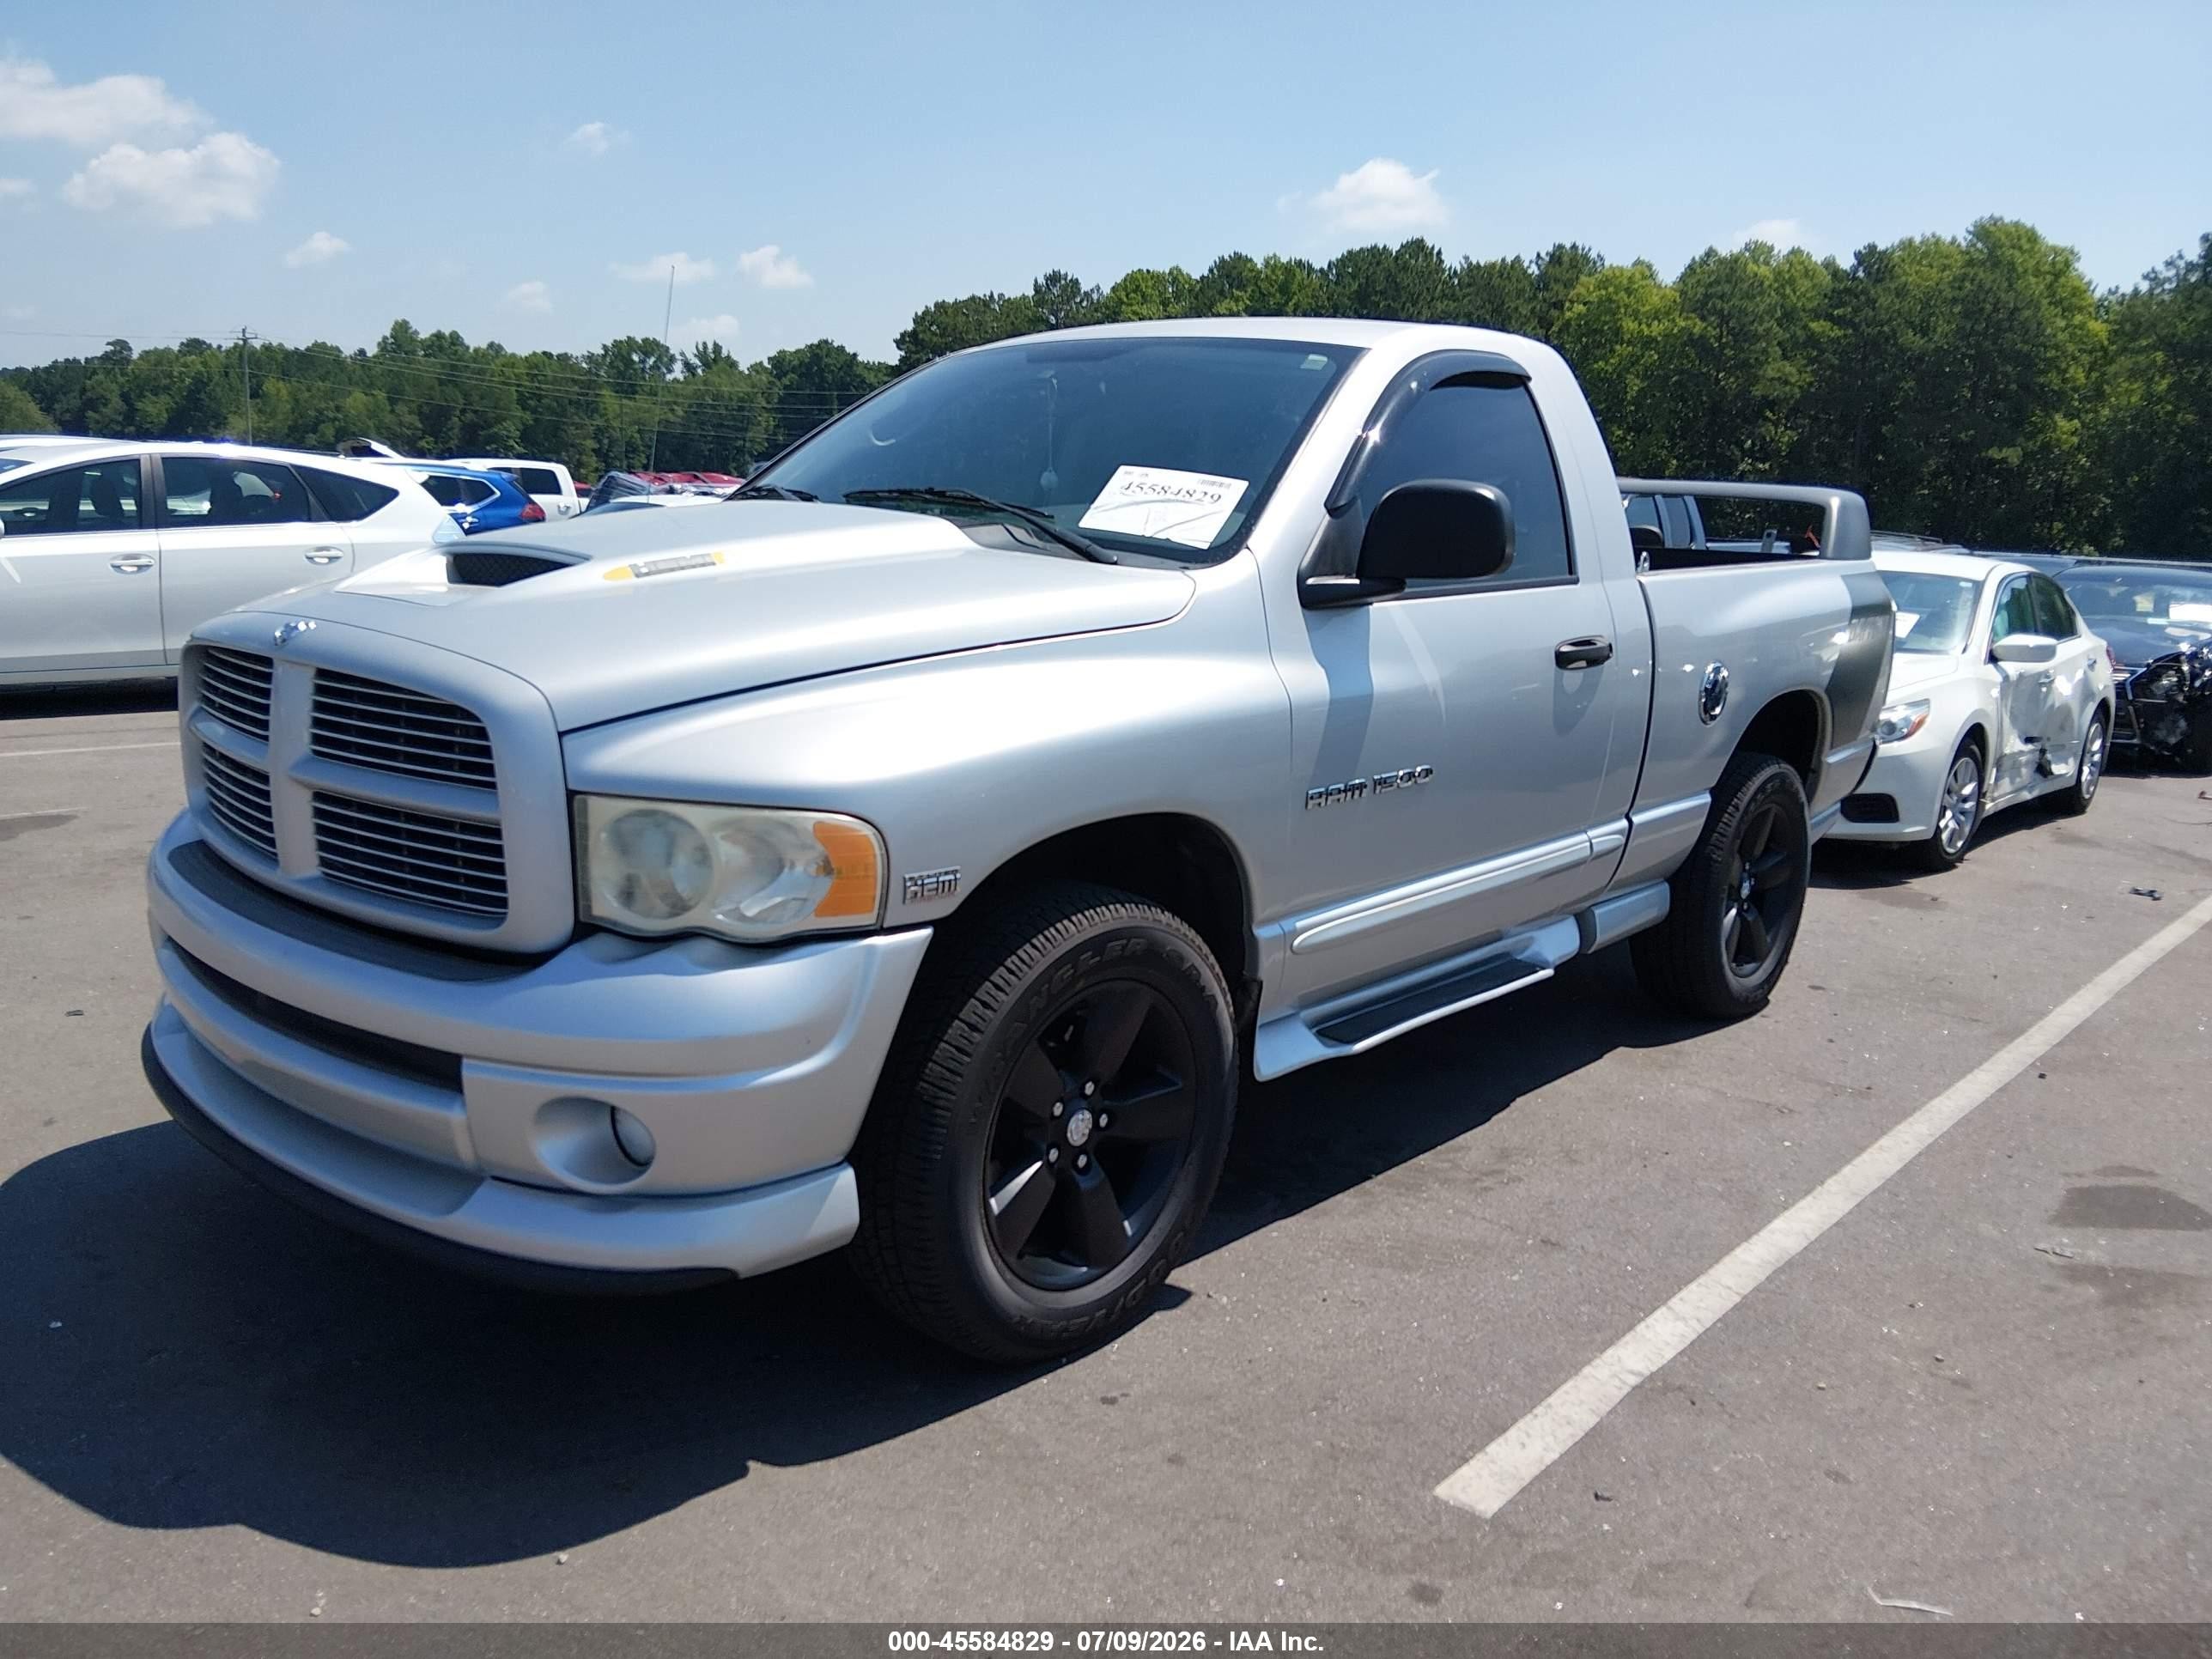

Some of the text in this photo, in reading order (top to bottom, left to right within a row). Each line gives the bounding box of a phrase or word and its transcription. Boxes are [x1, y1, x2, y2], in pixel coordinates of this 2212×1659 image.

[1120, 481, 1222, 505] 45584829
[1305, 764, 1433, 810] RAM 1500
